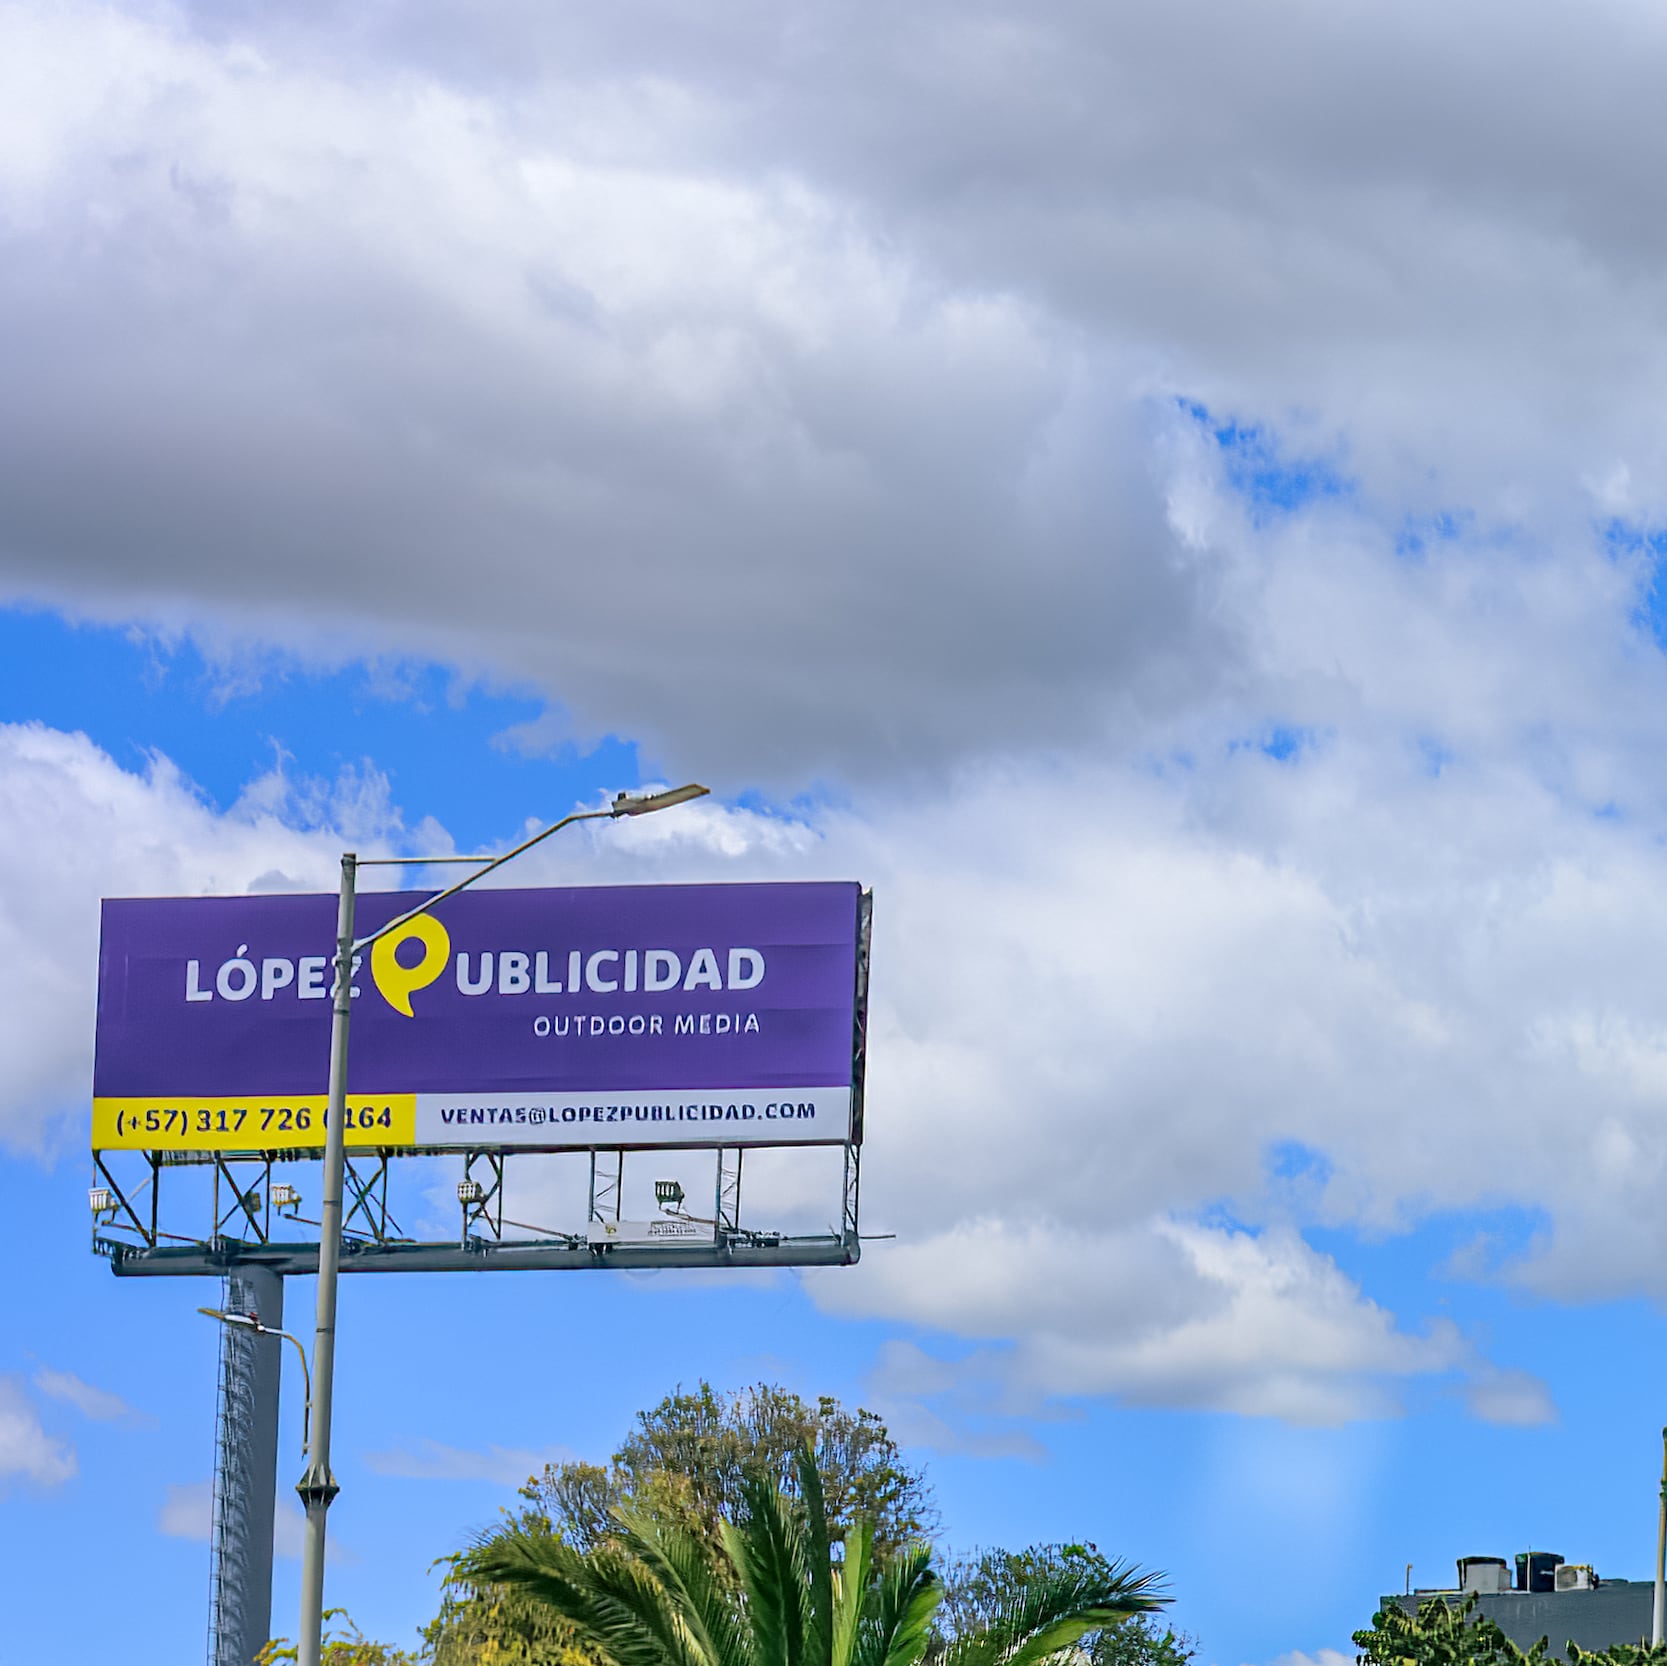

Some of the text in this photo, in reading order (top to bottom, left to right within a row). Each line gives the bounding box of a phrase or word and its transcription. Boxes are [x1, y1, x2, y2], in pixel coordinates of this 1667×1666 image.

[186, 944, 362, 1001] LÓPEZ
[533, 1013, 760, 1037] OUTDOOR MEDIA
[116, 1109, 188, 1137] (+57)
[196, 1109, 248, 1132] 317
[260, 1107, 312, 1131] 726
